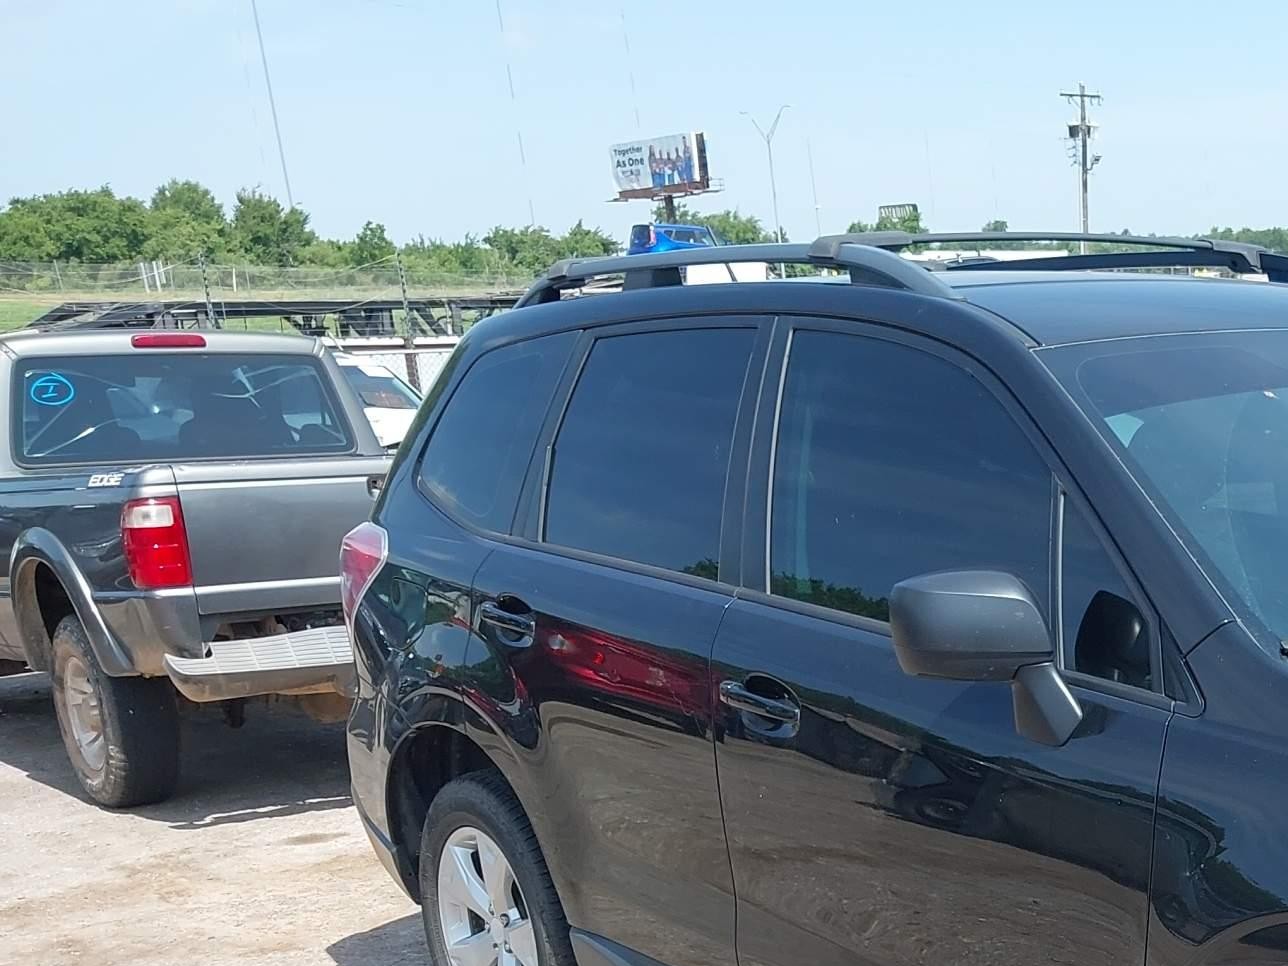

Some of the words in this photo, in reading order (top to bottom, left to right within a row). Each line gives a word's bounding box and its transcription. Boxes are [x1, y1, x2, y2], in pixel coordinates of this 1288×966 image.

[613, 146, 643, 157] Together
[616, 159, 627, 168] As
[628, 157, 645, 167] One
[88, 471, 125, 487] EDGE
